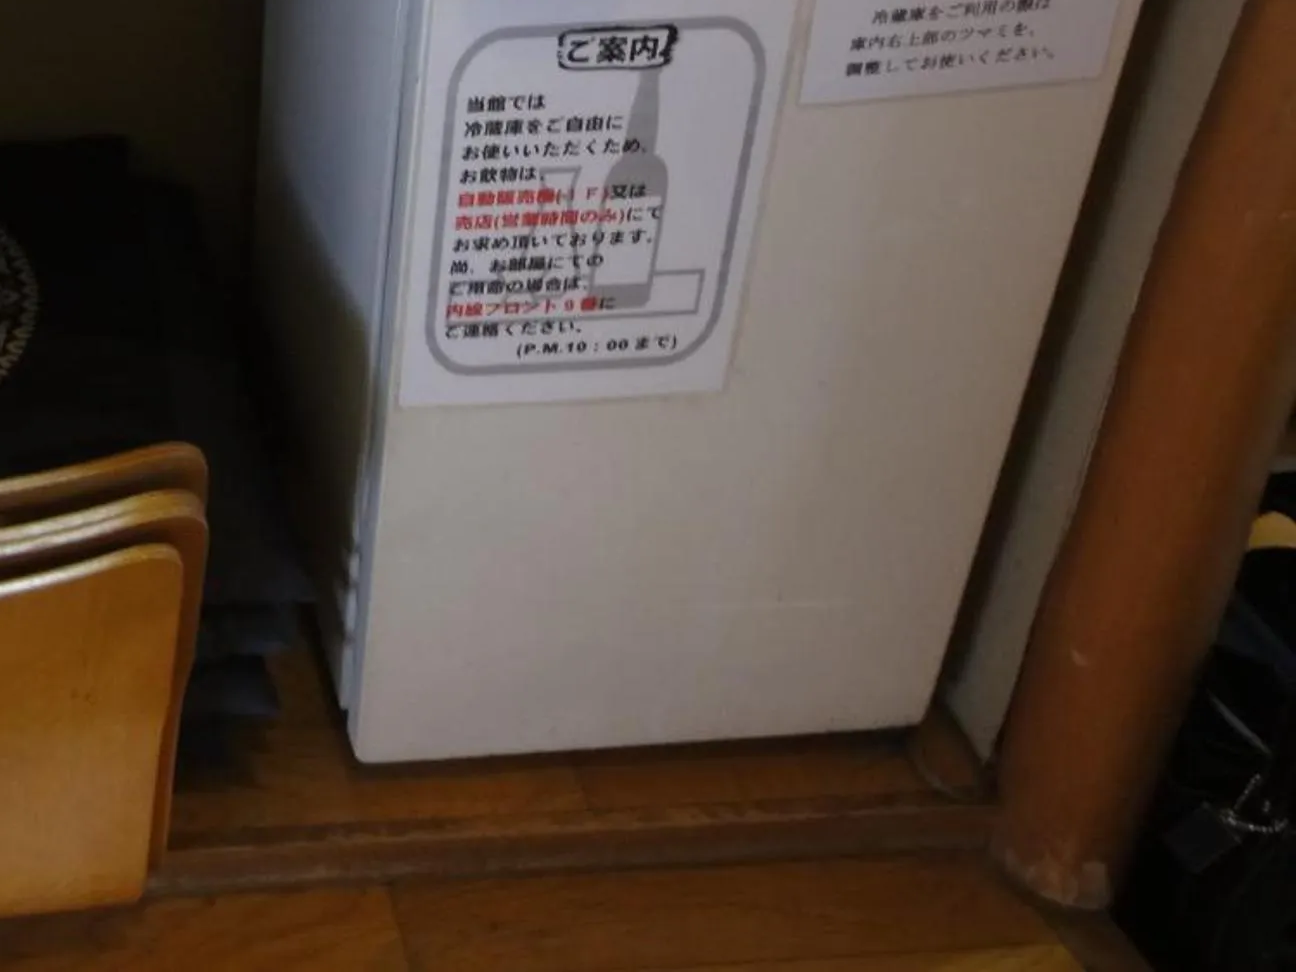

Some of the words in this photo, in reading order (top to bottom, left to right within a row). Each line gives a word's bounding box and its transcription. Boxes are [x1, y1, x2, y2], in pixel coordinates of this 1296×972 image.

[567, 34, 660, 64] ご案内
[467, 93, 547, 114] 当館では
[464, 115, 625, 138] 冷蔵庫をご自由に
[461, 138, 647, 161] お使いいただくため、
[459, 166, 546, 185] お飲物は、
[452, 228, 653, 253] お求め頂いております。
[444, 320, 583, 340] ご連絡ください。
